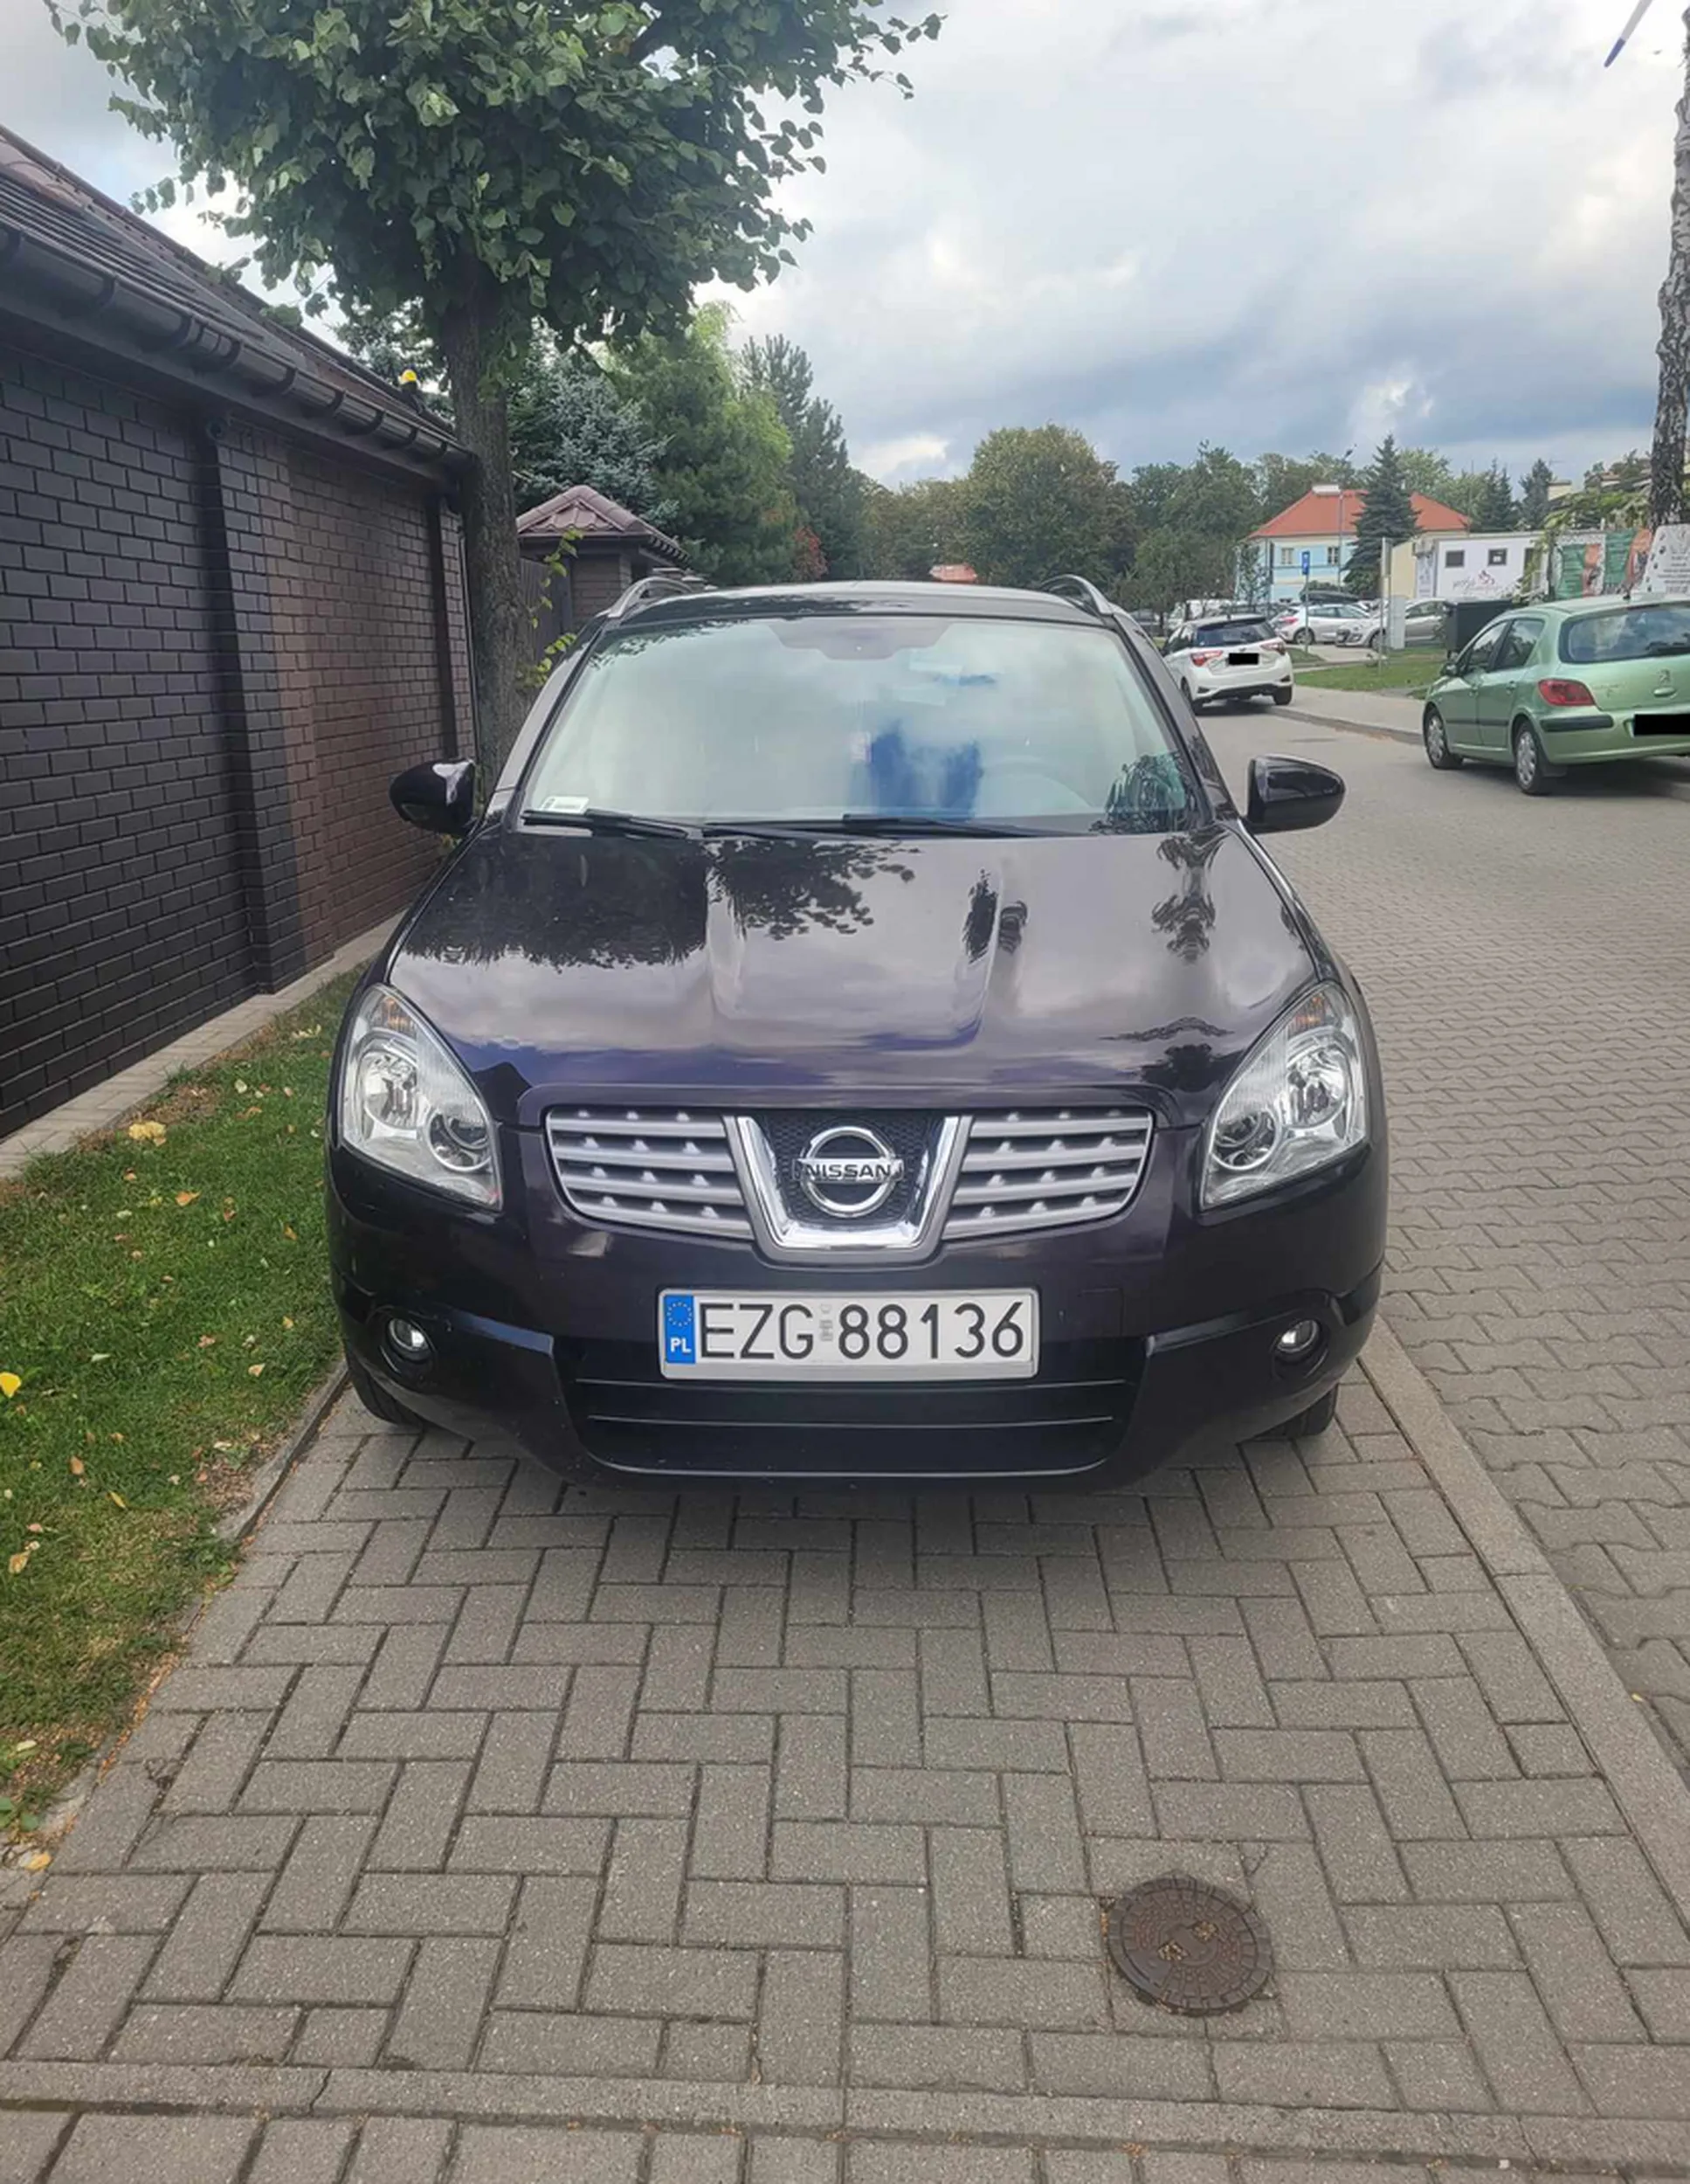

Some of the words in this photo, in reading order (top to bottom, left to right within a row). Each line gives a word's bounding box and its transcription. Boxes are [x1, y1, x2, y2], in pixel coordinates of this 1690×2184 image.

[804, 1164, 891, 1178] NISSAN
[699, 1302, 814, 1360] EZG
[838, 1302, 1024, 1360] 88136
[670, 1337, 692, 1353] PL
